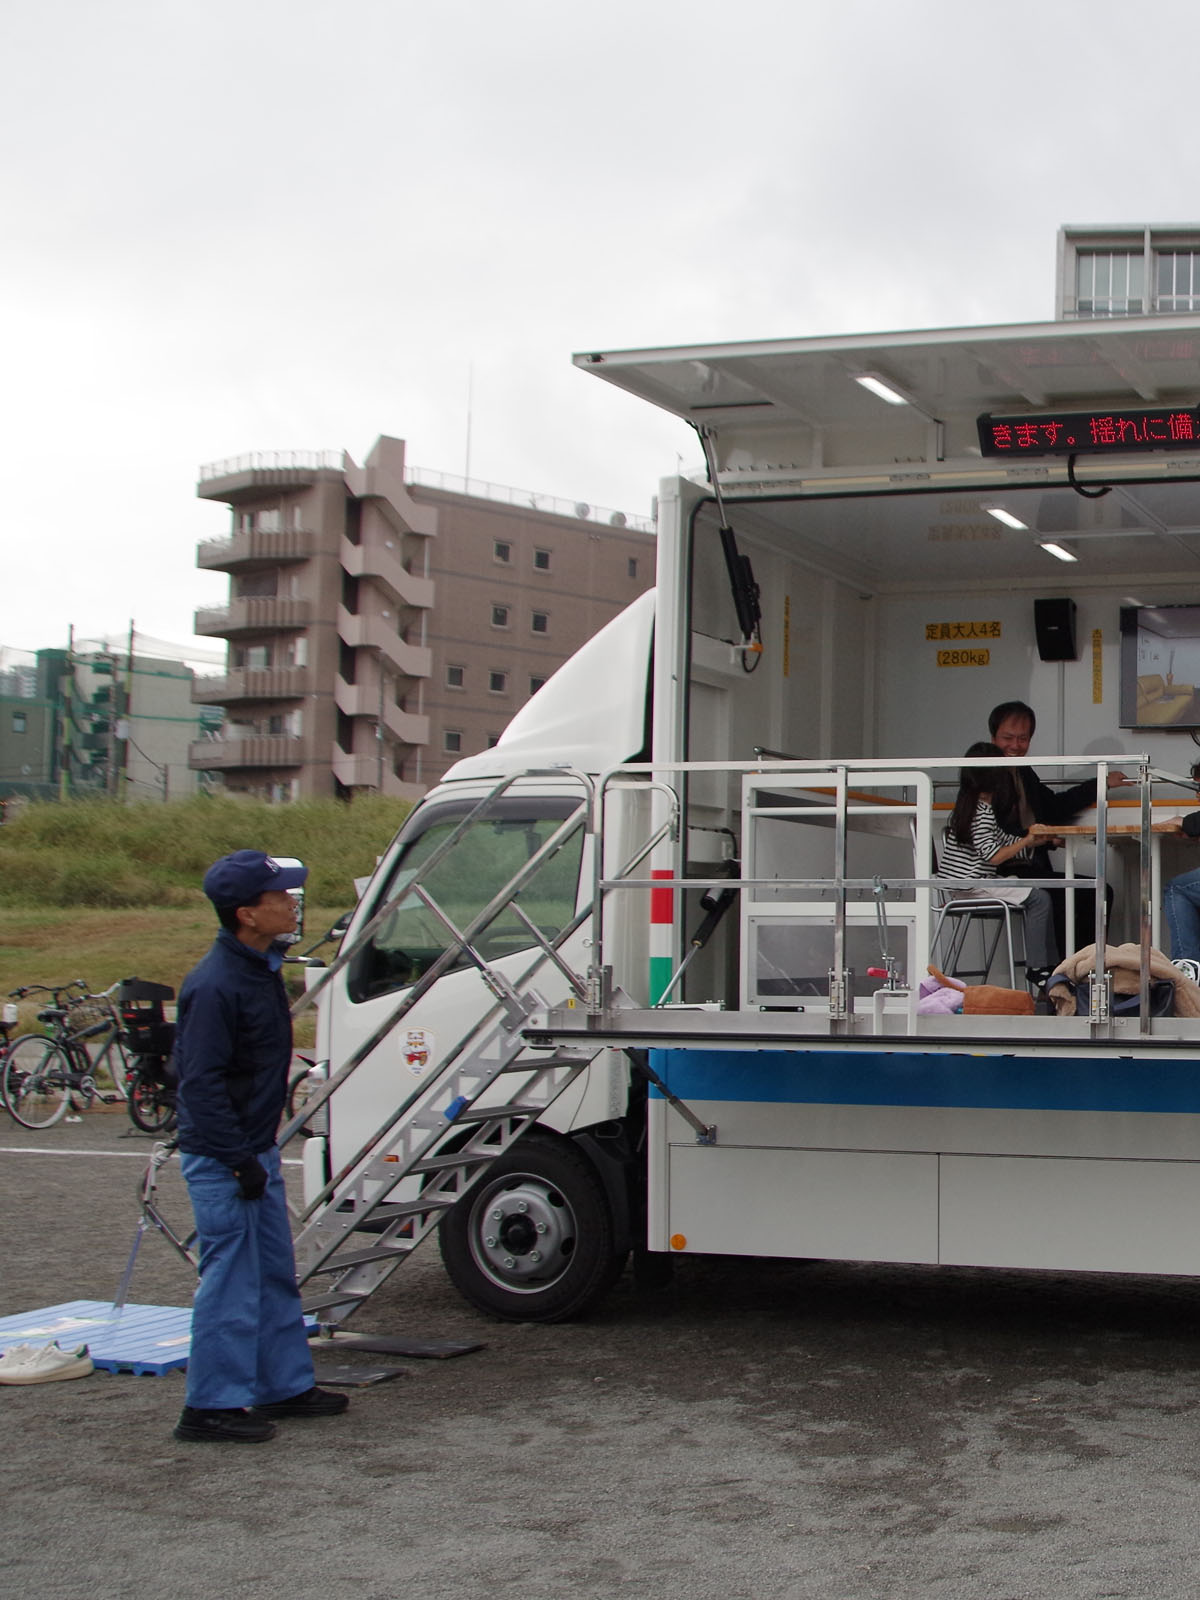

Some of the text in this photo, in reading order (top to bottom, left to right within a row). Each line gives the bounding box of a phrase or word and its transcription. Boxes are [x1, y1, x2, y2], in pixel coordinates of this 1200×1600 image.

[992, 413, 1200, 448] きます。揺れに備
[926, 621, 1001, 640] 定員大人4名
[937, 649, 990, 667] (280kg)
